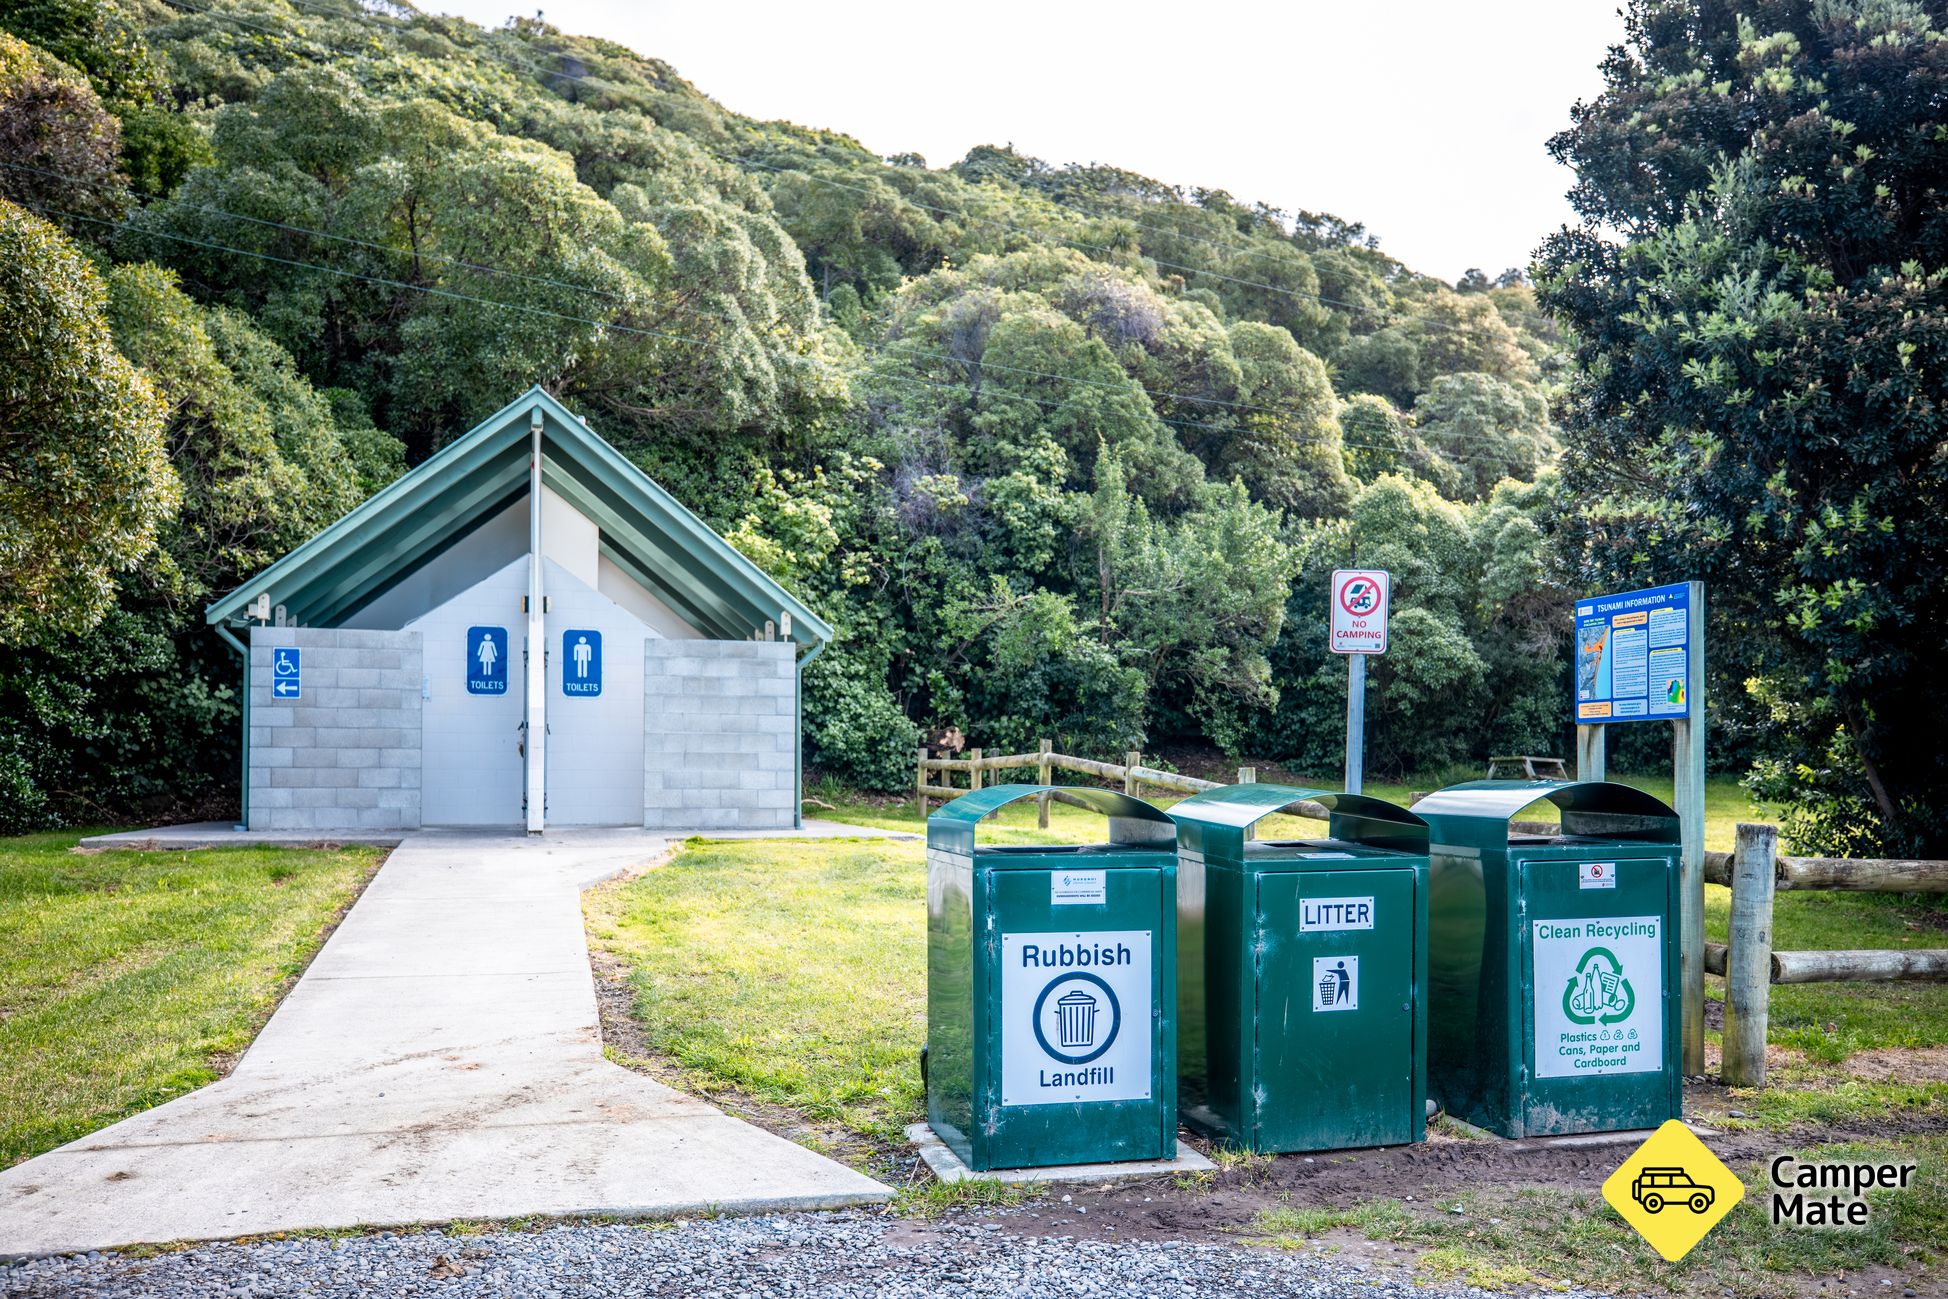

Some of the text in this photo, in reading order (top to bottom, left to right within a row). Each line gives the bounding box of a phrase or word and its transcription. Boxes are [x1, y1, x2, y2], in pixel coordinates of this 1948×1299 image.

[1597, 601, 1624, 613] TSUNAMI
[1624, 594, 1666, 609] INFORMATION
[1352, 620, 1367, 628] NO
[1336, 630, 1382, 639] CAMPING
[470, 680, 504, 690] TOILETS
[566, 683, 599, 692] TOILETS
[1305, 904, 1369, 925] LITTER
[1539, 922, 1656, 940] Clean Recycling
[1022, 943, 1131, 967] Rubbish
[1560, 1032, 1597, 1043] Plastics
[1559, 1042, 1640, 1056] Cans, Paper and
[1574, 1056, 1627, 1068] Cardboard
[1040, 1067, 1113, 1087] Landfill
